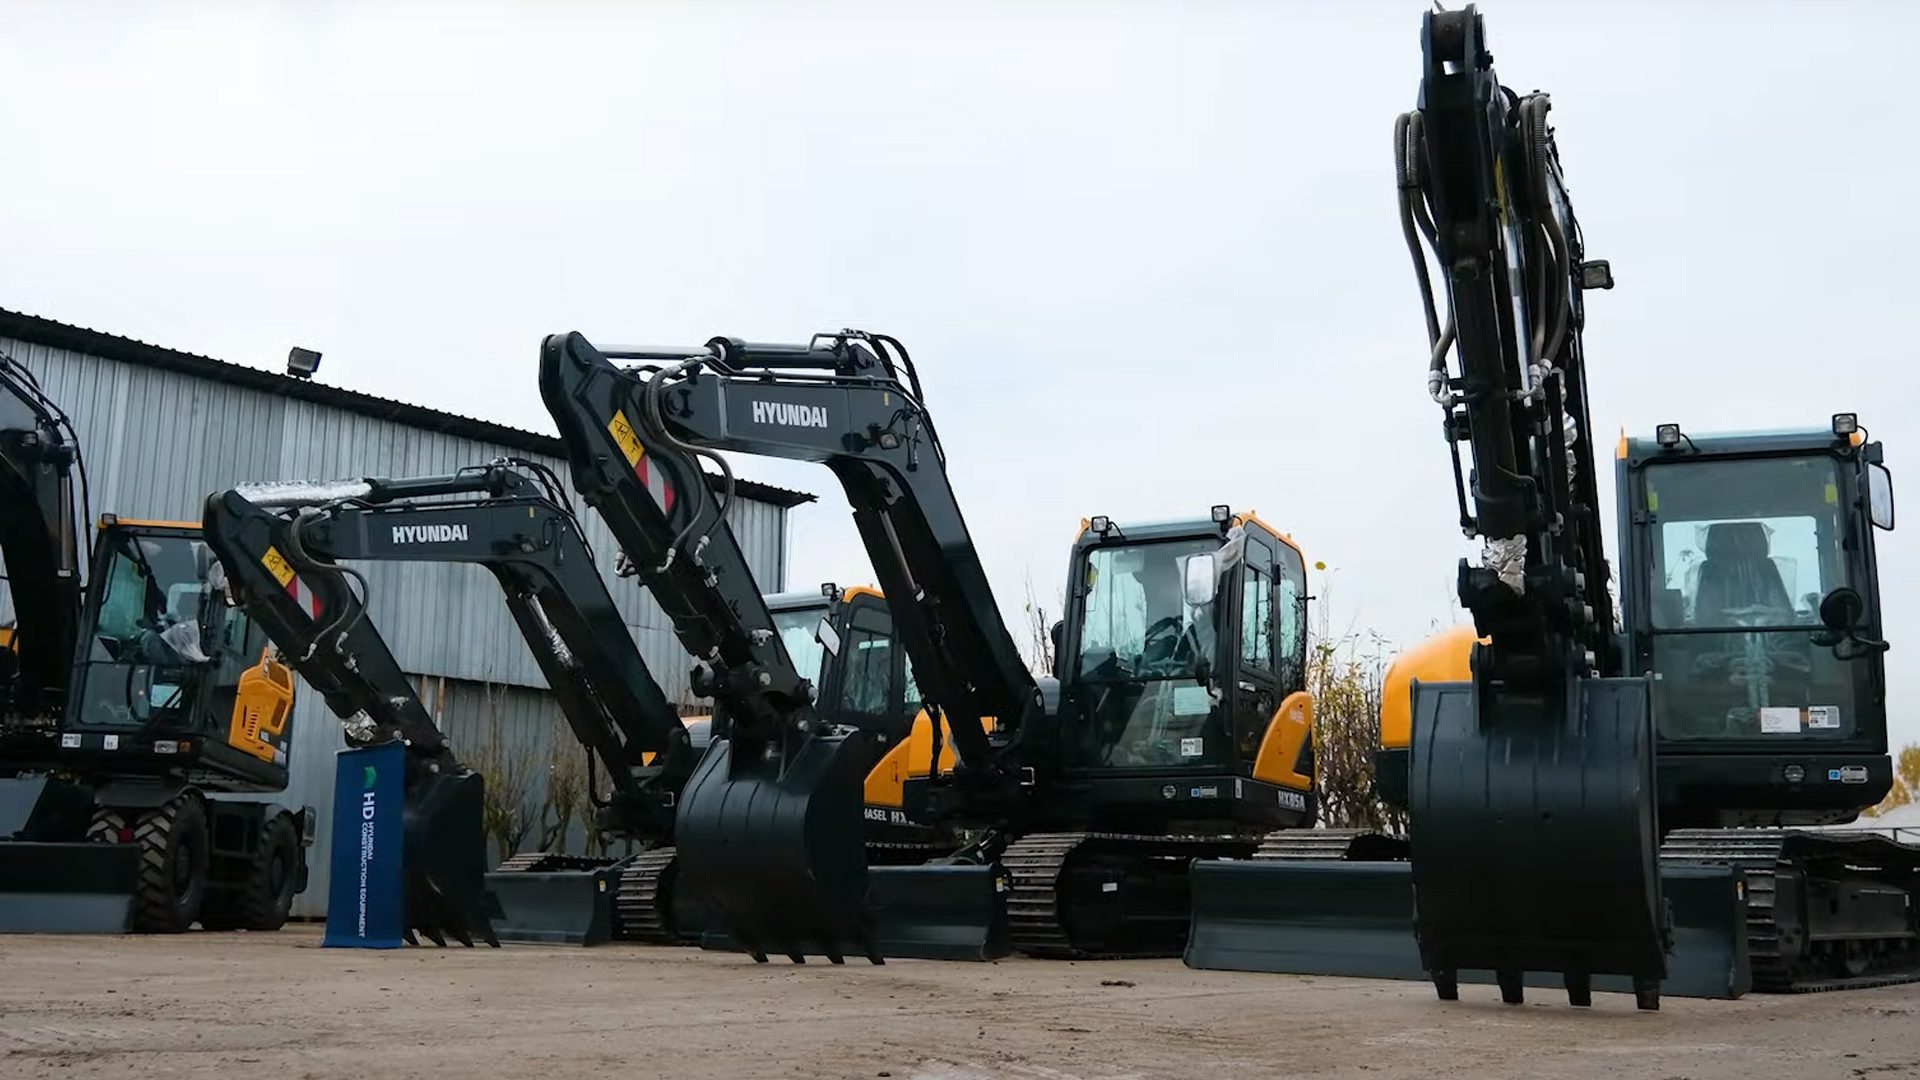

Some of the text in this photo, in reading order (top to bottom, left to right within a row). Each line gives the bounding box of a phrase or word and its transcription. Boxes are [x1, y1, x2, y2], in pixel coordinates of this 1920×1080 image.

[752, 400, 828, 429] HYUNDAI
[391, 524, 469, 544] HYUNDAI
[362, 792, 375, 820] HD
[359, 888, 367, 938] EQUIPMENT
